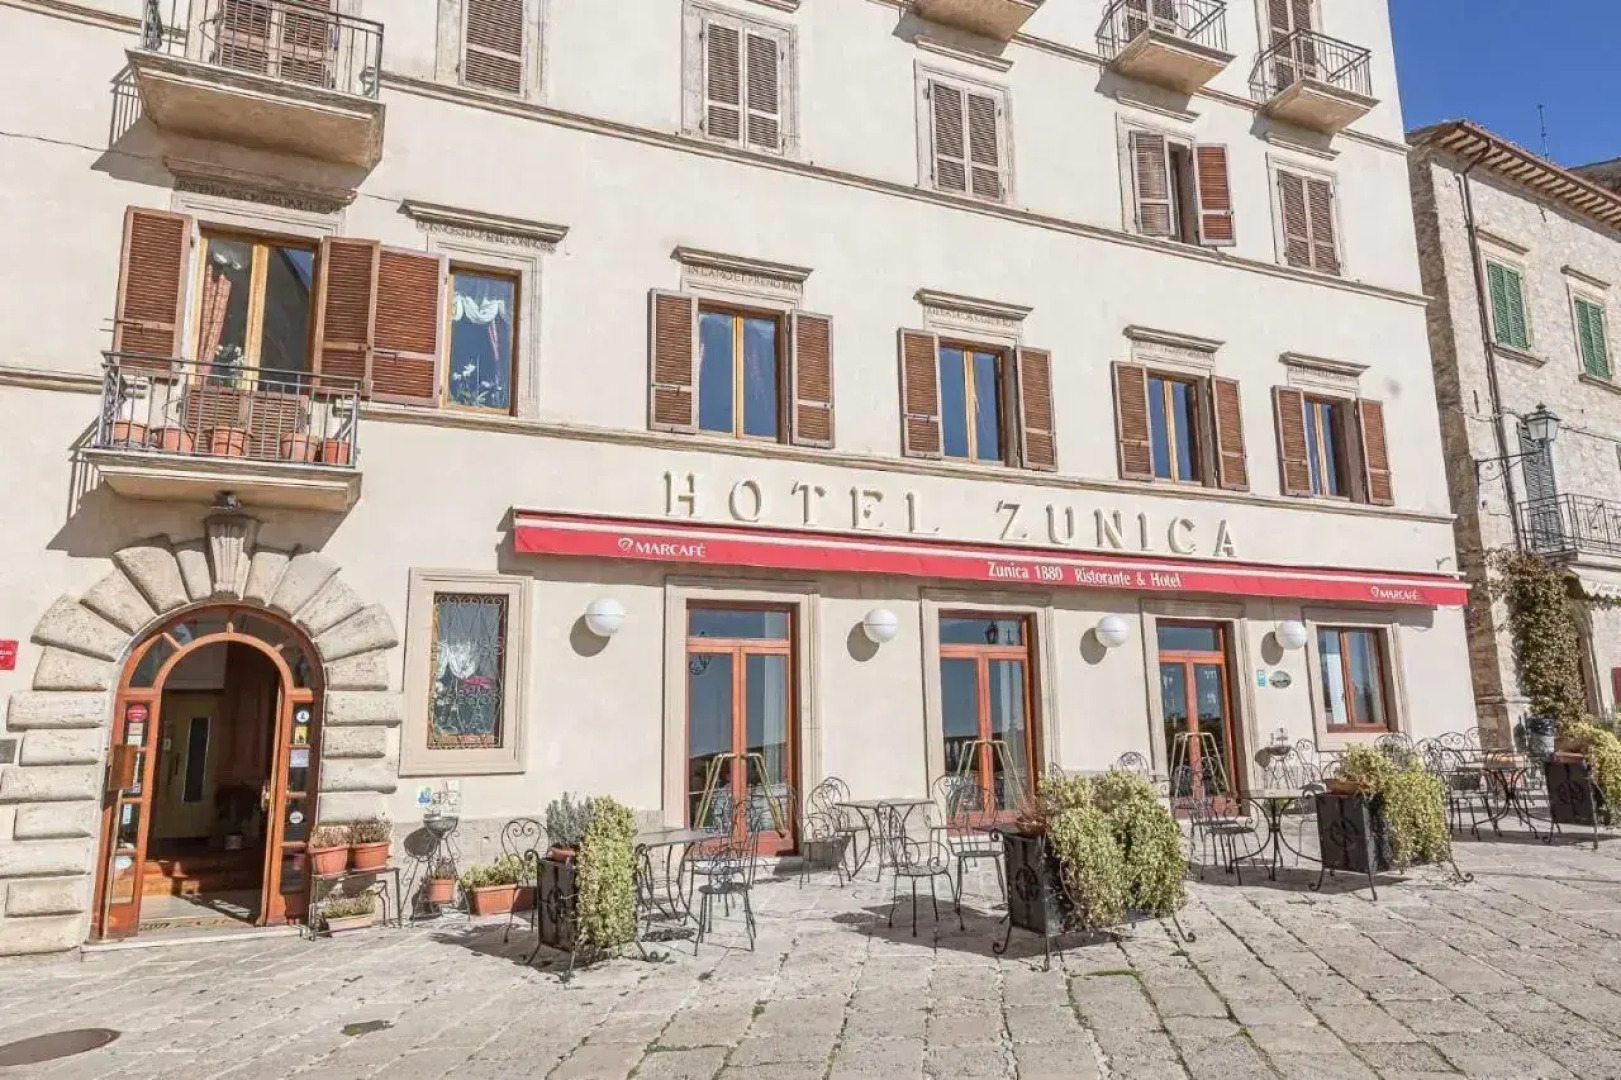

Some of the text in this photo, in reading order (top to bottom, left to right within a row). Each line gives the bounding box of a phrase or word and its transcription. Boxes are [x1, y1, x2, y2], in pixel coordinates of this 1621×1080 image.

[663, 470, 1238, 558] HOTEL ZUNICA
[635, 541, 707, 558] MARCAFÉ
[987, 561, 1182, 588] Zunica 1880 Ristorante & Hotel
